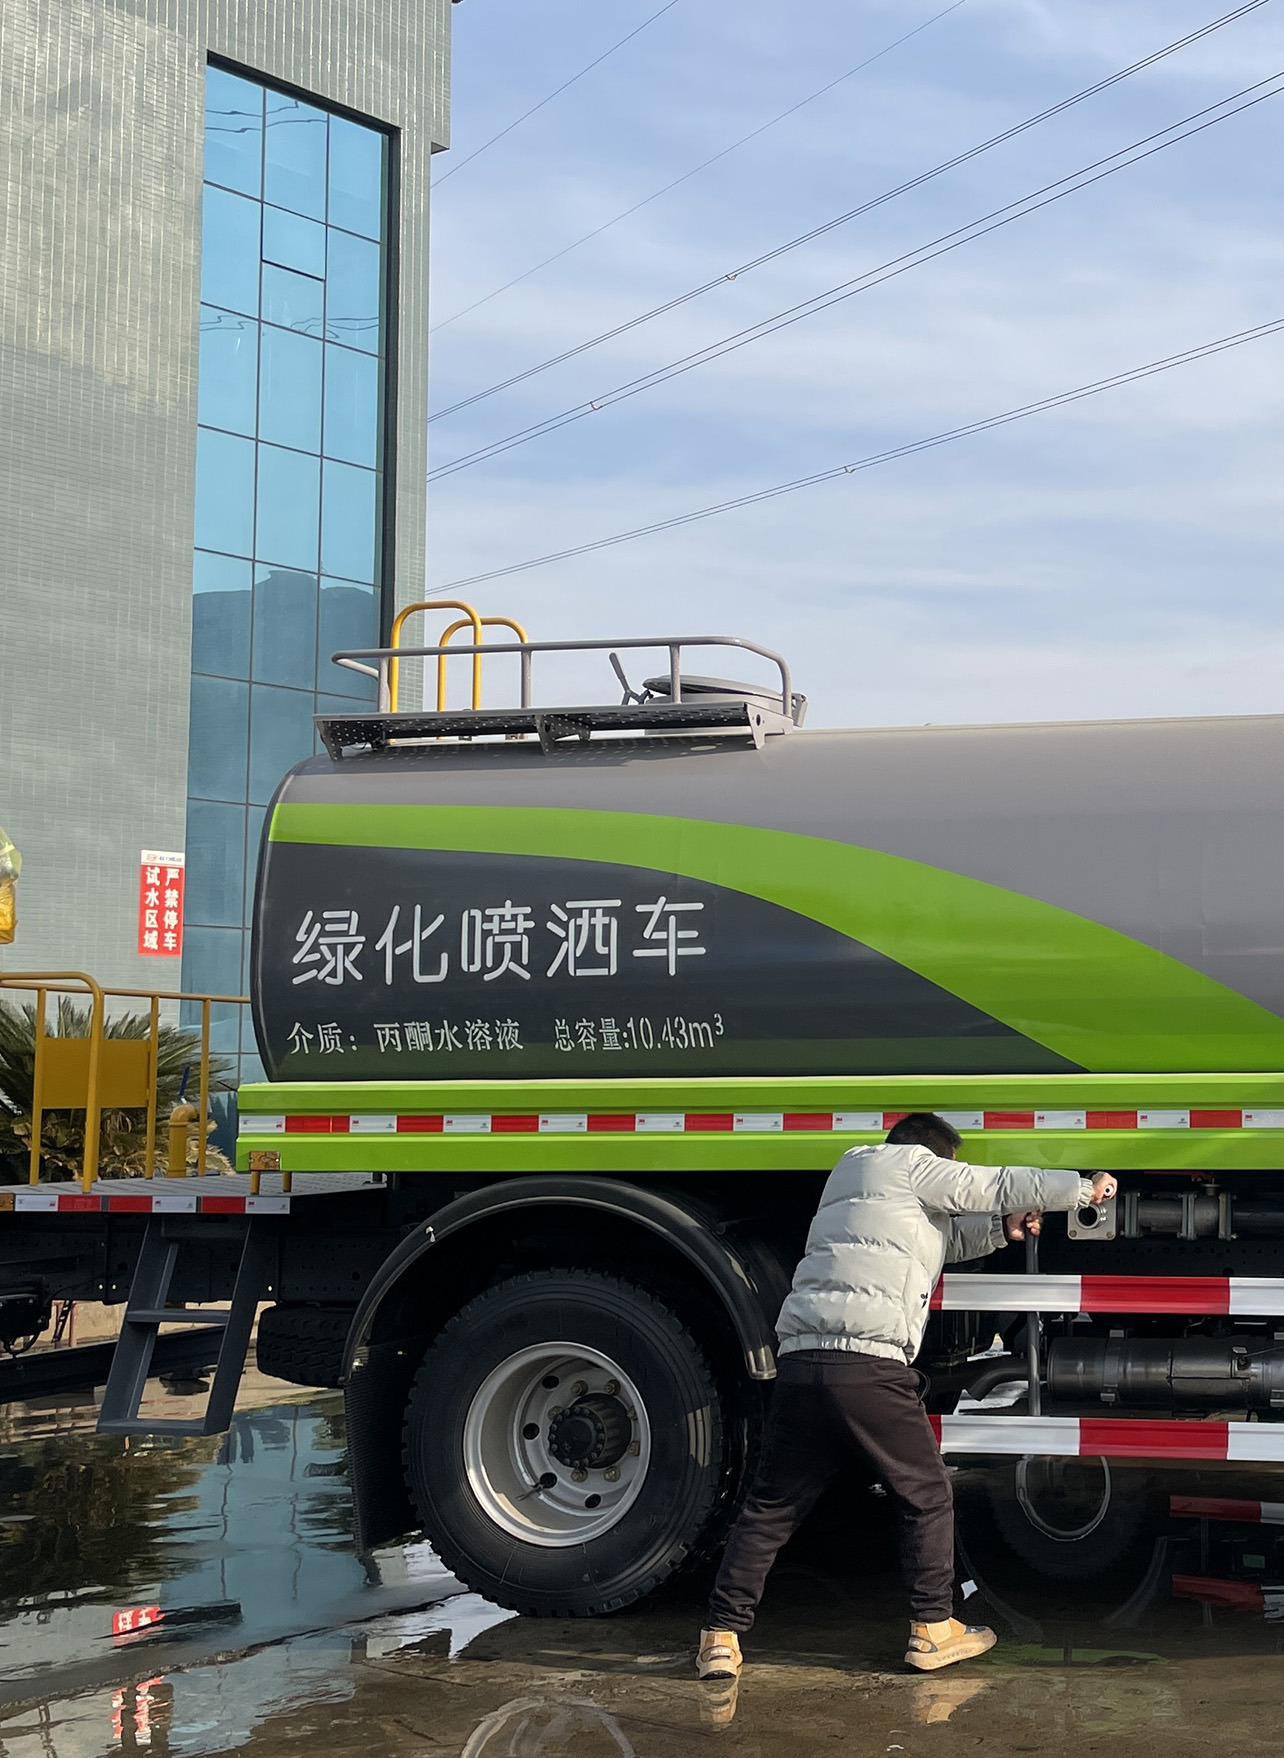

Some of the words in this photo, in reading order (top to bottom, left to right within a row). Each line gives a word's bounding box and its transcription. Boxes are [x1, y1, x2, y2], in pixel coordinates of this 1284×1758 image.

[143, 866, 161, 950] 试水区域
[163, 867, 180, 951] 严禁停车
[292, 896, 707, 986] 绿化喷洒车
[373, 1018, 524, 1053] 丙酮水溶液
